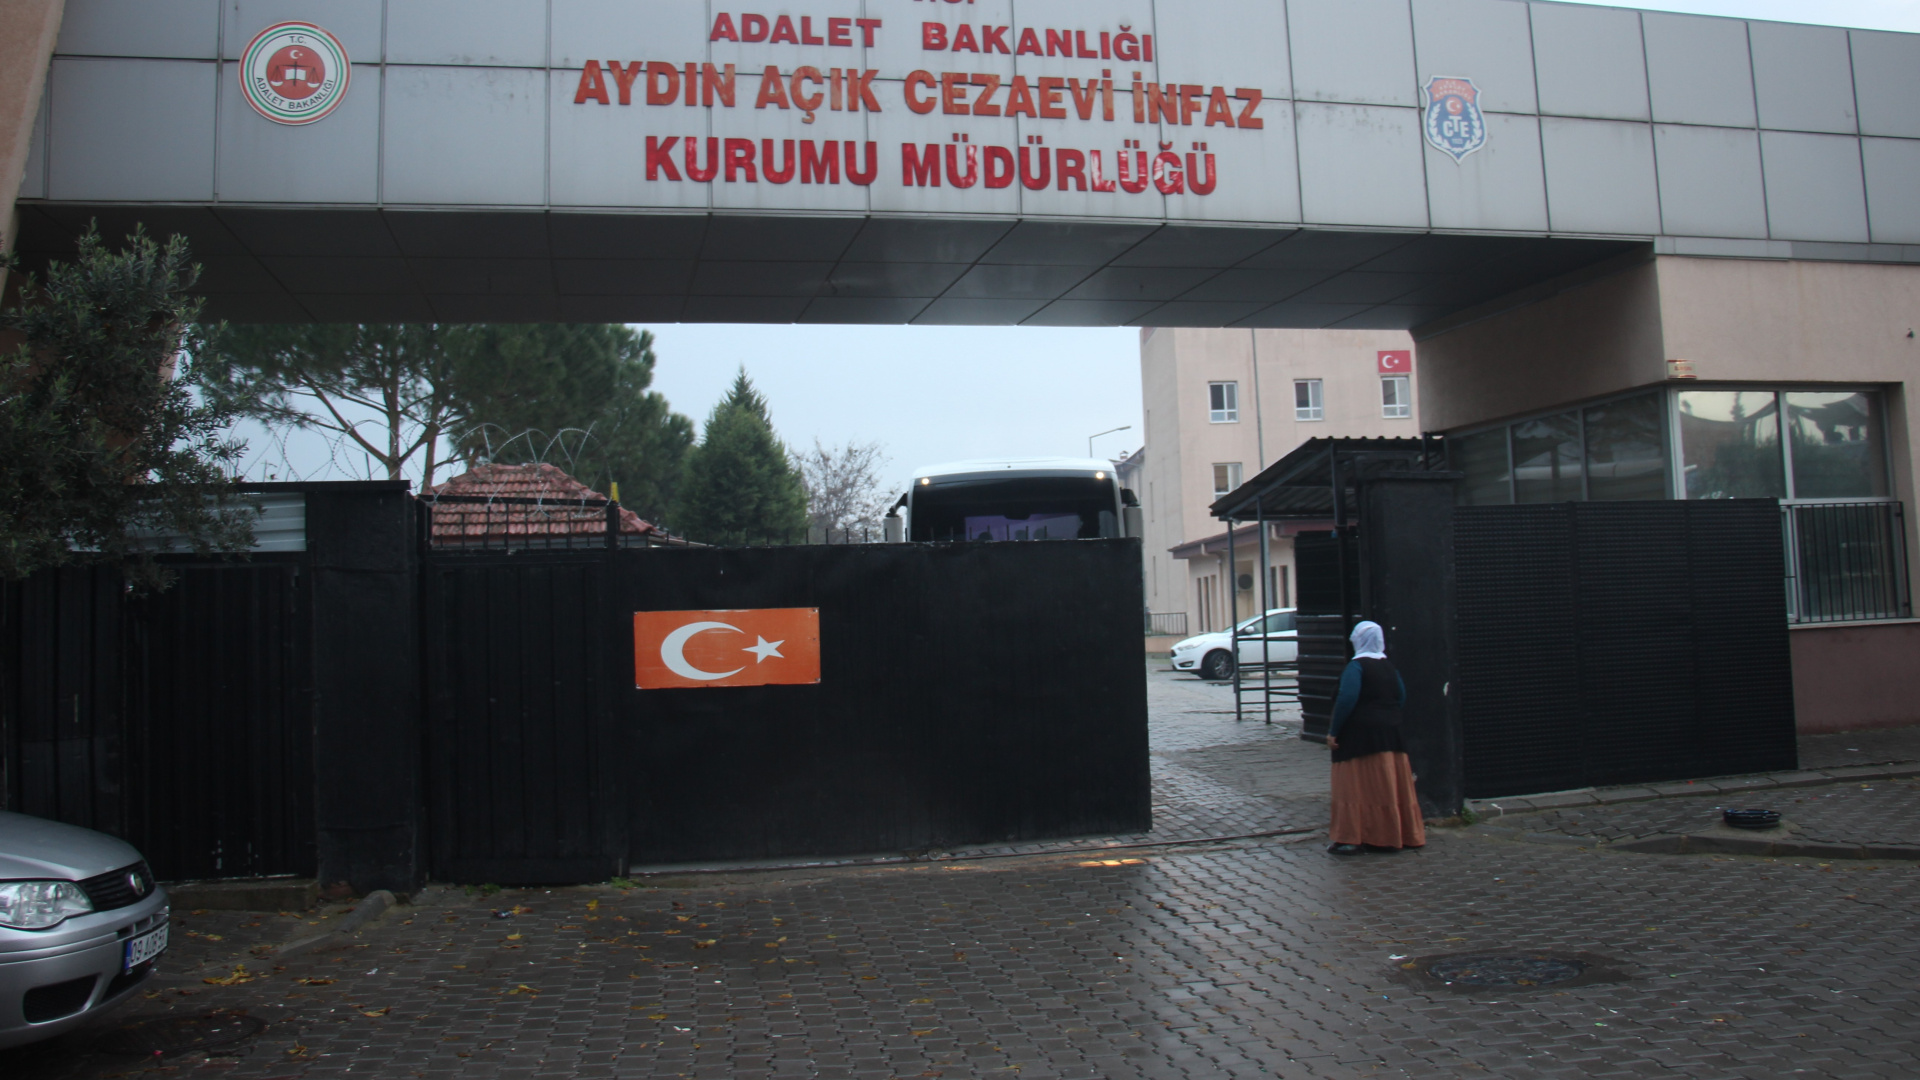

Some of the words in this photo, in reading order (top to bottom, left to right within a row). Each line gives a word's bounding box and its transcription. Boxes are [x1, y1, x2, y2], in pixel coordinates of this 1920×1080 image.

[709, 12, 883, 48] ADALET
[922, 21, 1153, 62] BAKANLIĞI
[256, 77, 286, 107] ADALET
[574, 59, 736, 108] AYDIN
[755, 65, 882, 123] AÇIK
[903, 69, 1115, 121] CEZAEVİ
[1132, 71, 1264, 130] İNFAZ
[645, 135, 879, 186] KURUMU
[901, 132, 1218, 196] MÜDÜRLÜĞÜ
